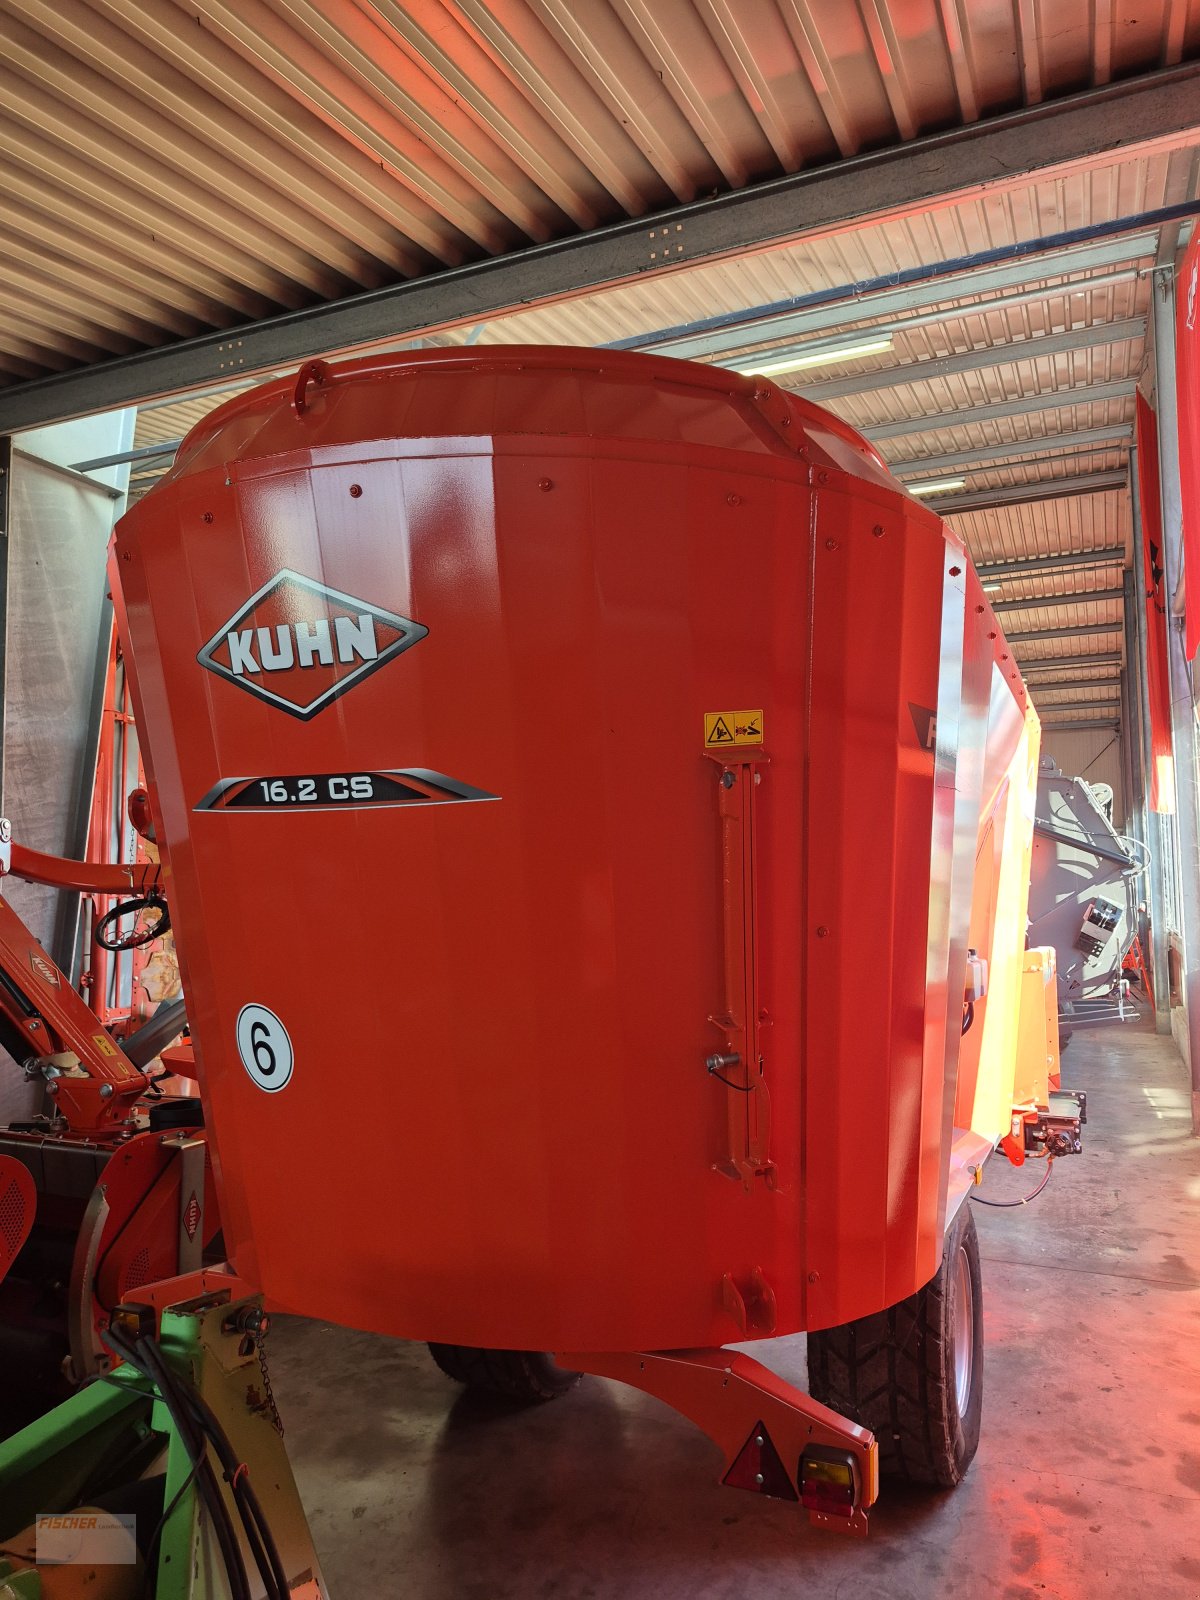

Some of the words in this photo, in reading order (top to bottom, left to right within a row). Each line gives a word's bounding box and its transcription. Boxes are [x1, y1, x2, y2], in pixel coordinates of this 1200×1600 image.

[227, 614, 378, 676] KUHN
[260, 780, 318, 802] 16.2
[328, 776, 374, 799] CS
[32, 957, 59, 984] KUHN
[251, 1021, 276, 1076] 6
[189, 1199, 197, 1234] KUHN
